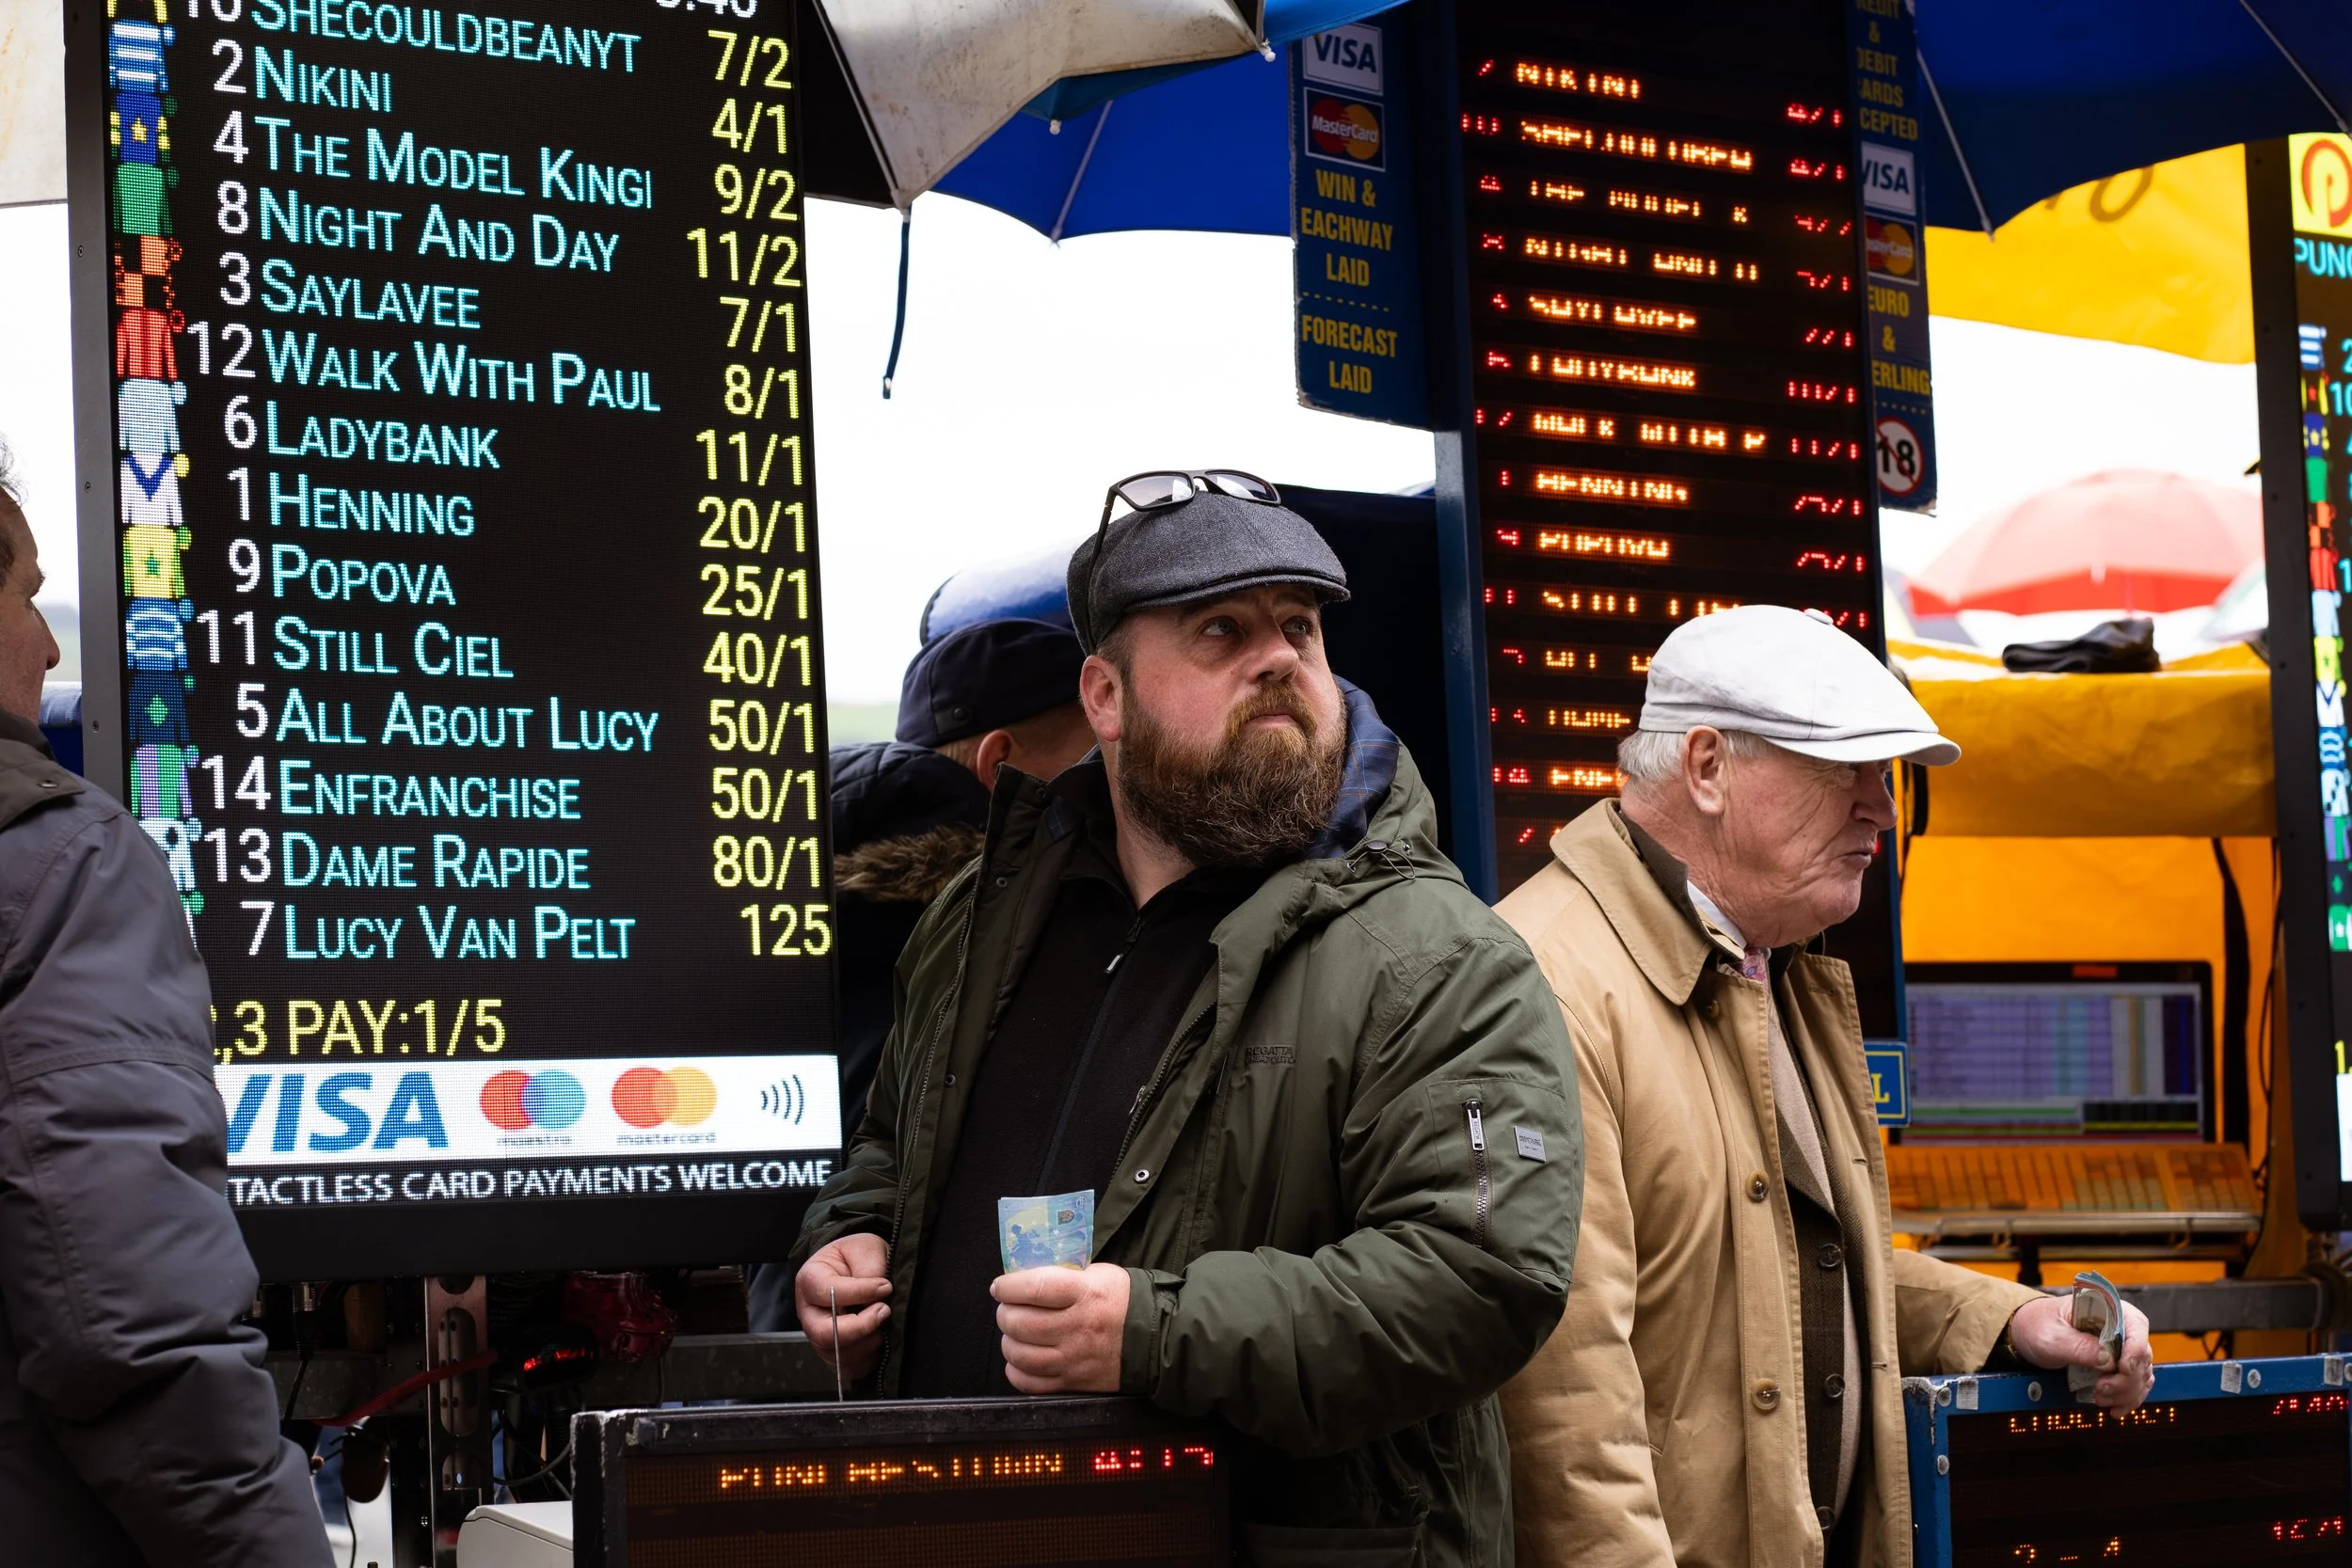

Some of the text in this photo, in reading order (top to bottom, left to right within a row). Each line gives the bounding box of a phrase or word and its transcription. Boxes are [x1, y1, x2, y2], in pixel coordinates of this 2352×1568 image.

[707, 29, 792, 89] 7/2
[1314, 34, 1376, 73] VISA
[212, 39, 787, 154] 2 NIKINI 4/1
[1858, 77, 1904, 108] ARDS
[1312, 115, 1377, 142] MasterCard
[213, 110, 249, 164] 4
[254, 116, 351, 178] THE
[367, 128, 525, 196] MODEL
[714, 164, 798, 221] 9/2
[1316, 168, 1376, 207] WIN &
[216, 180, 802, 287] 8 NIGHT AND DAY 11/2
[1301, 207, 1392, 251] EACHWAY
[1327, 252, 1370, 287] LAID
[219, 251, 796, 353] 3 SAYLAVEE 7/1
[1302, 314, 1397, 357] FORECAST
[1882, 325, 1896, 353] &
[186, 321, 800, 420] 12 WALK WITH PAUL 8/1
[1328, 360, 1372, 394] LAID
[224, 395, 803, 486] 6 LADYBANK 11/1
[1878, 439, 1915, 477] 18
[227, 467, 805, 554] 1 HENNING 20/1
[228, 538, 808, 621] 9 POPOVA 25/1
[196, 610, 811, 689] 11 STILL CIEL 40/1
[235, 682, 815, 755] 5 ALL ABOUT LUCY 50/1
[200, 755, 817, 823] 14 ENFRANCHISE 50/1
[203, 828, 820, 891] 13 DAME RAPIDE 80/1
[239, 900, 831, 959] 7 LUCY VAN PELT 125
[401, 1169, 497, 1200] CARD
[503, 1164, 672, 1197] PAYMENTS
[676, 1159, 833, 1191] WELCOME
